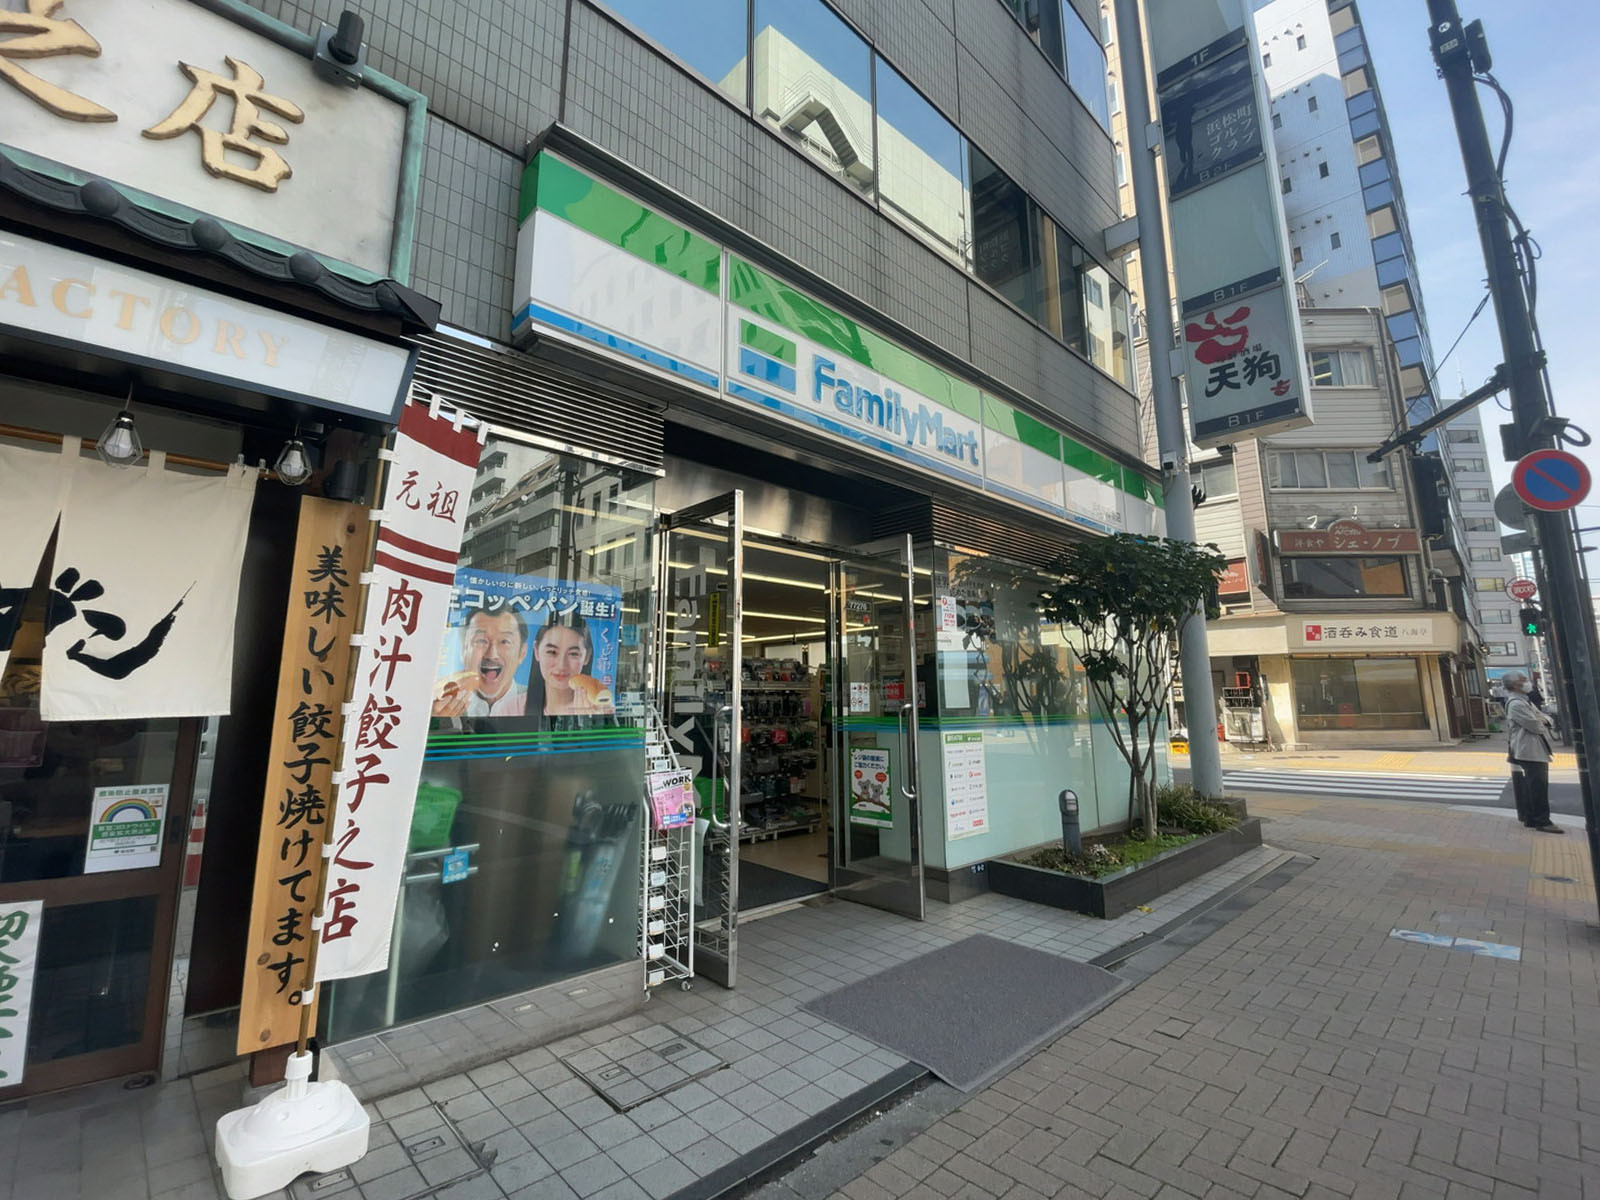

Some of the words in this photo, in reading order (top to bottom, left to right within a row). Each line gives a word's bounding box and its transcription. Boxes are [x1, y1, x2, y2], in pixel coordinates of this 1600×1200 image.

[1191, 48, 1209, 66] 1F
[1209, 118, 1252, 147] ゴルフ
[1211, 127, 1256, 160] クラブ
[1214, 284, 1248, 301] B1F
[1205, 351, 1281, 398] 天狗
[812, 353, 979, 467] FamilyMart
[1228, 411, 1265, 428] B1F
[396, 470, 460, 524] 元祖
[1323, 625, 1399, 639] 酒呑み食道
[321, 577, 424, 945] 肉汁餃子之店
